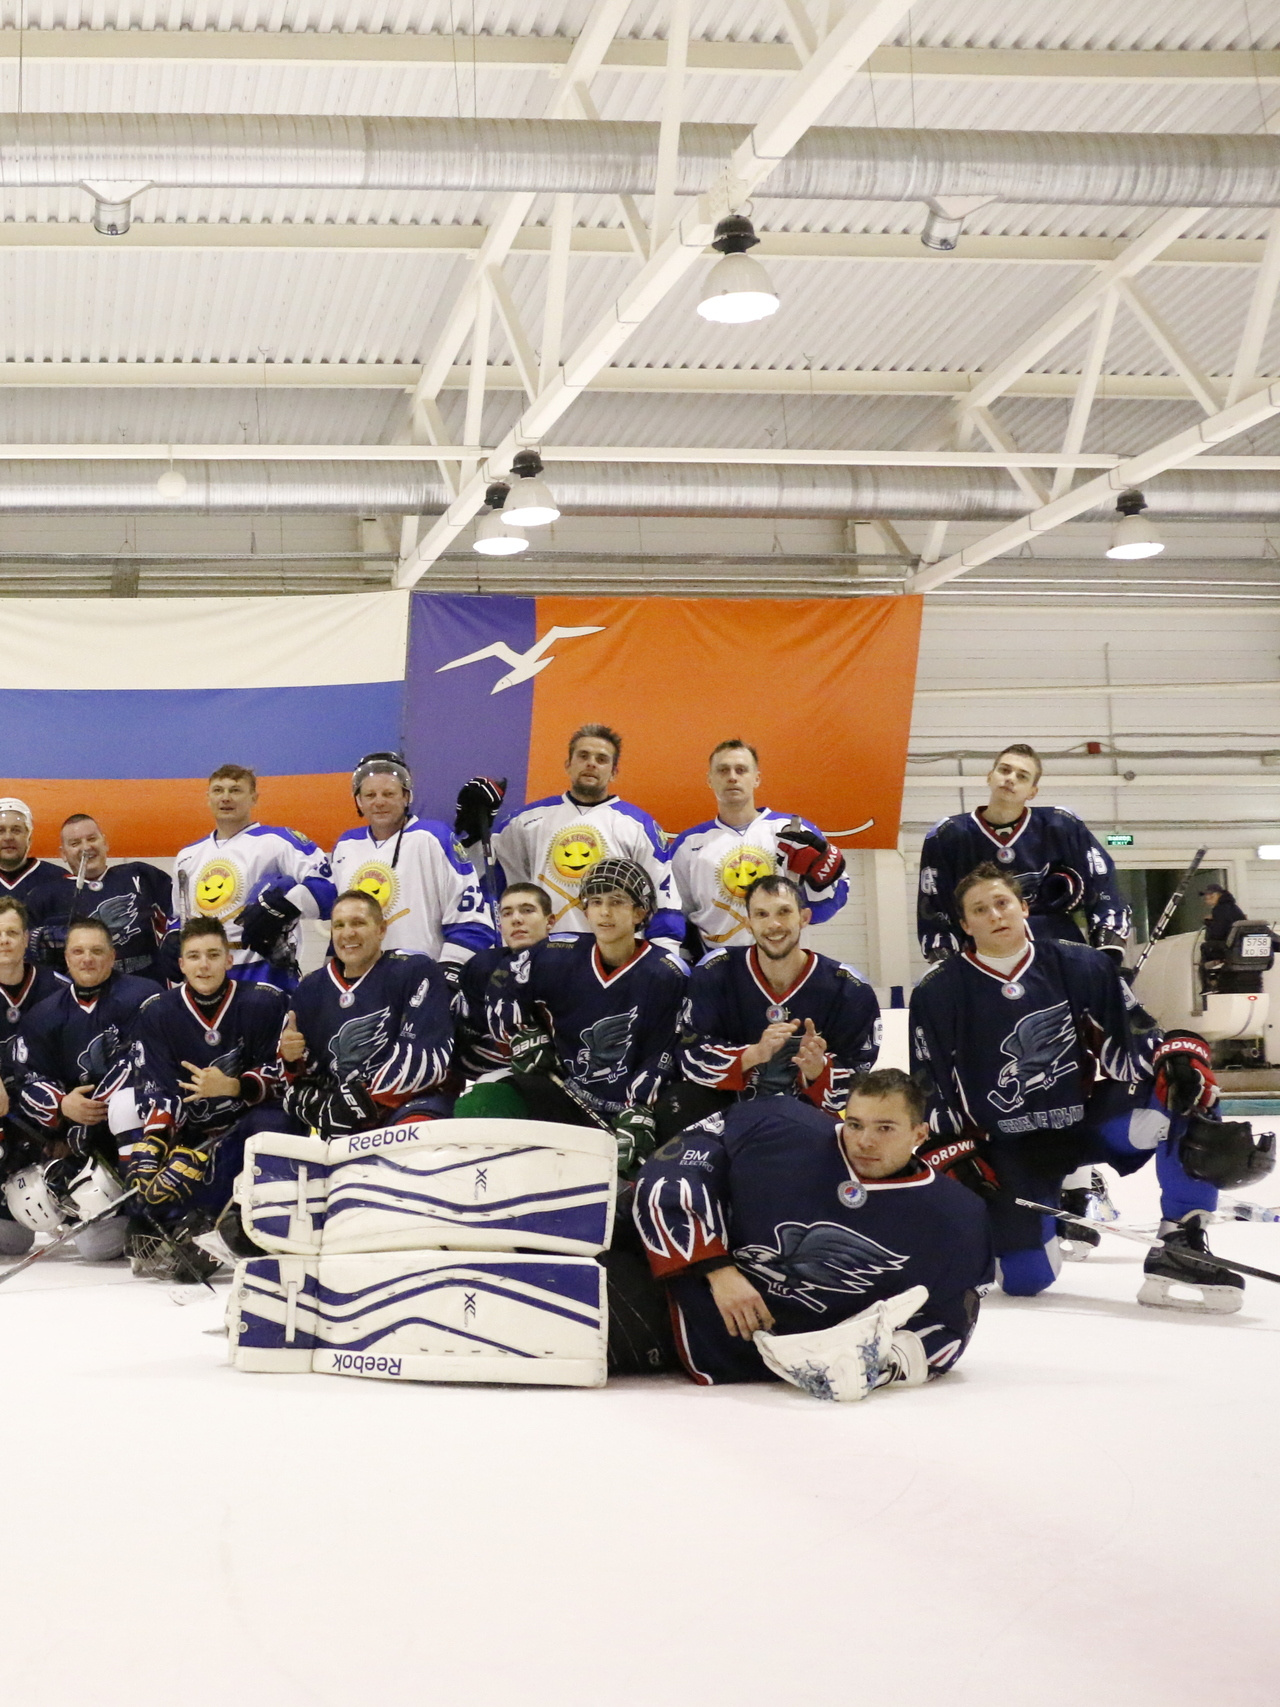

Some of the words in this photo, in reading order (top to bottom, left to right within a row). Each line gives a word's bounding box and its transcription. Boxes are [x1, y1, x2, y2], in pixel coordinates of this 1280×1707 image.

[1247, 938, 1268, 946] 5758
[512, 1034, 550, 1056] BAUE
[340, 1083, 367, 1120] UER
[349, 1126, 420, 1153] Reebok
[683, 1149, 710, 1161] BM
[928, 1140, 976, 1166] ORDWA
[679, 1160, 714, 1173] ELECTRO
[332, 1354, 402, 1376] Reebok
